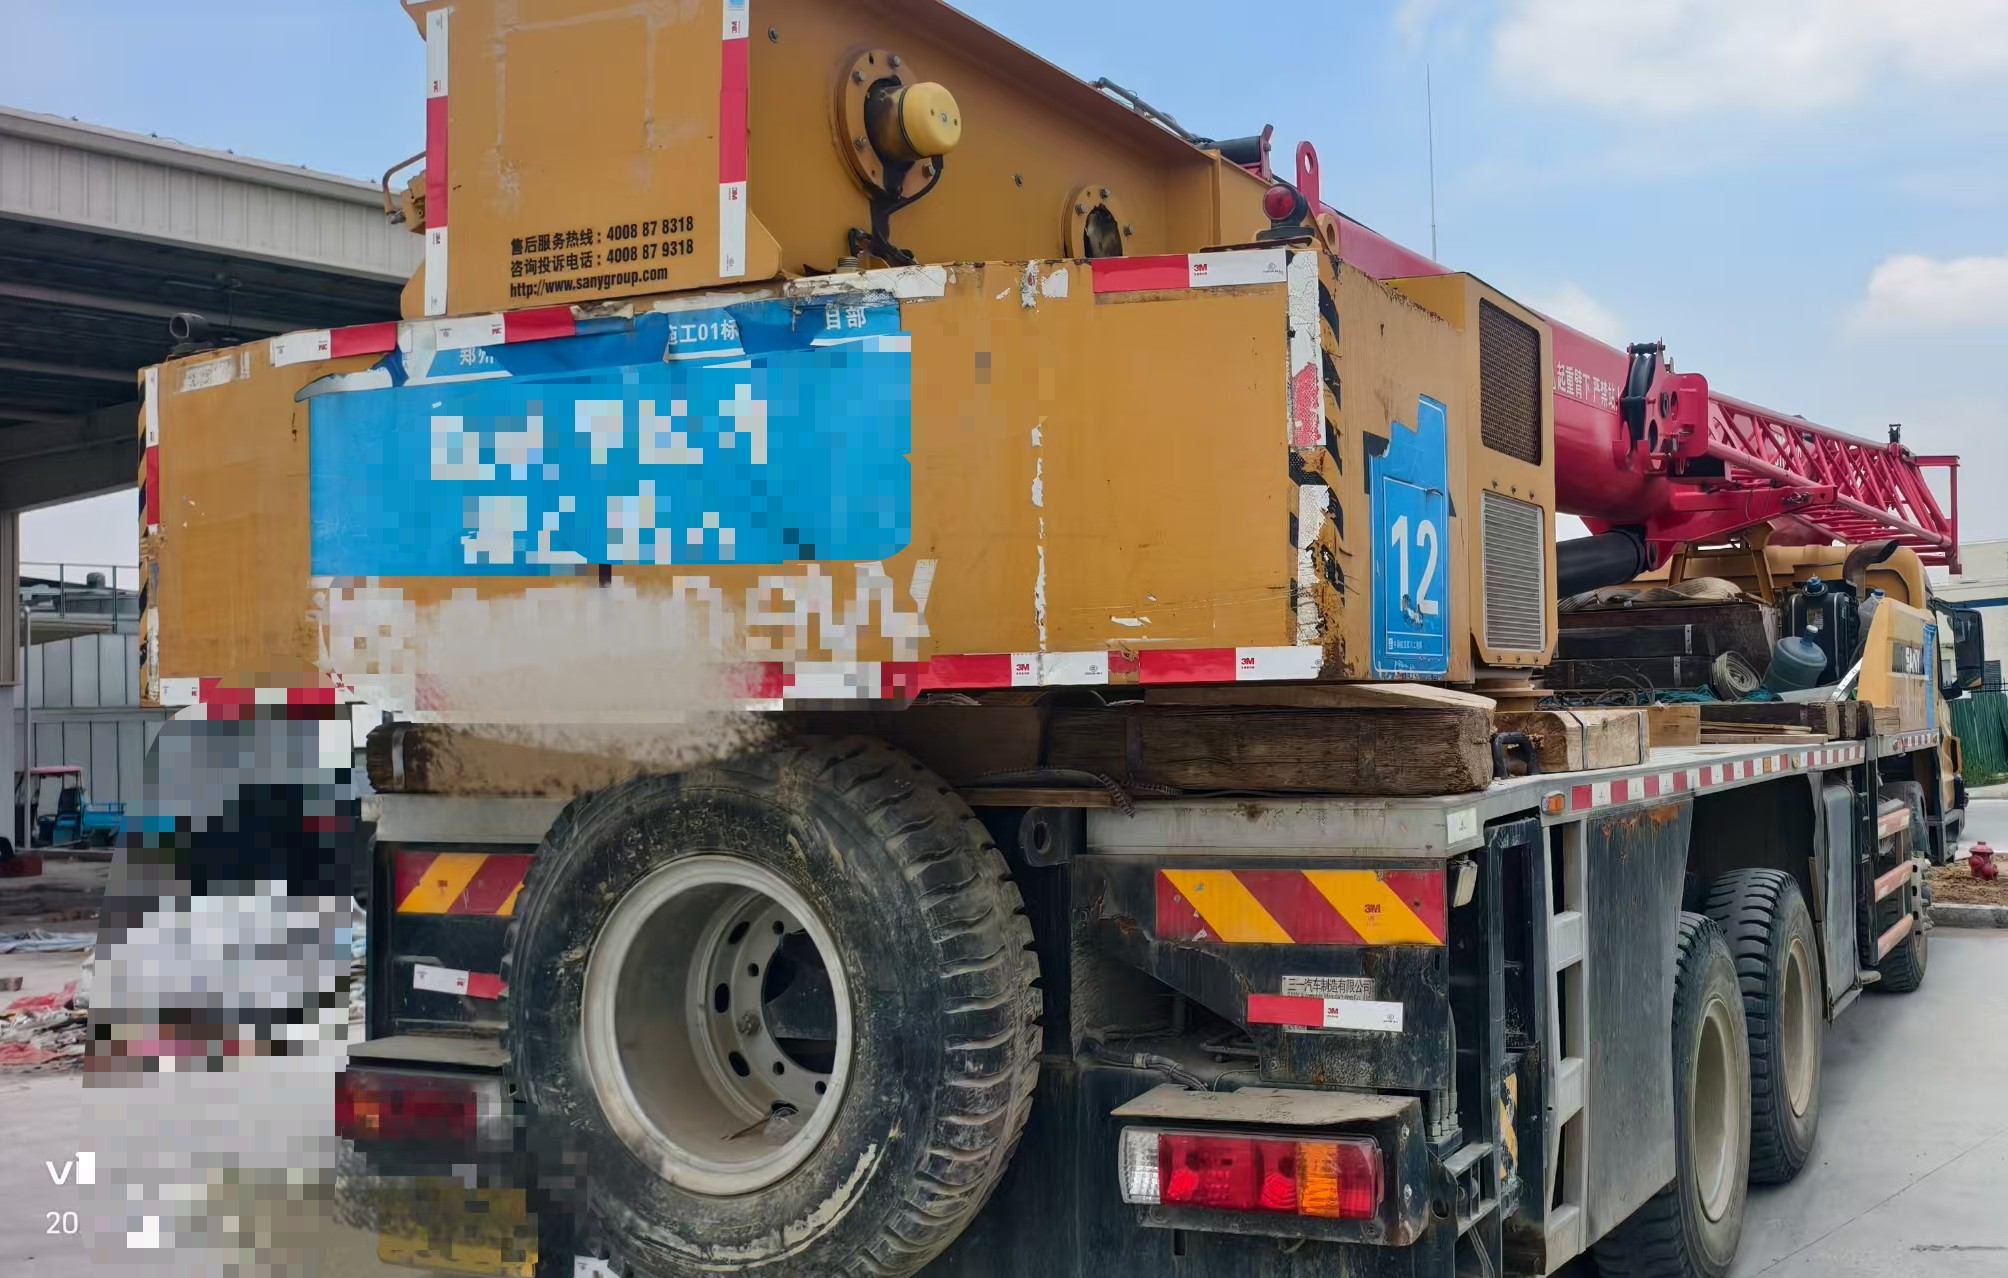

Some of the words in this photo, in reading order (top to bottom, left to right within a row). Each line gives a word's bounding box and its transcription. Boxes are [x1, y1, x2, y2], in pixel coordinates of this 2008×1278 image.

[606, 223, 638, 242] 4008
[642, 221, 658, 237] 87
[662, 215, 694, 235] 8318
[606, 246, 638, 264] 4008
[642, 243, 658, 260] 87
[662, 239, 694, 257] 9318
[1193, 263, 1208, 272] 3M
[510, 267, 668, 299] http://www.sanygroup.com
[1391, 514, 1439, 615] 12
[1015, 663, 1030, 671] 3M
[1241, 657, 1255, 665] 3M
[1364, 903, 1381, 914] 3M
[1286, 977, 1373, 995] 三一汽车制造有限公司
[1327, 1007, 1339, 1015] 3M
